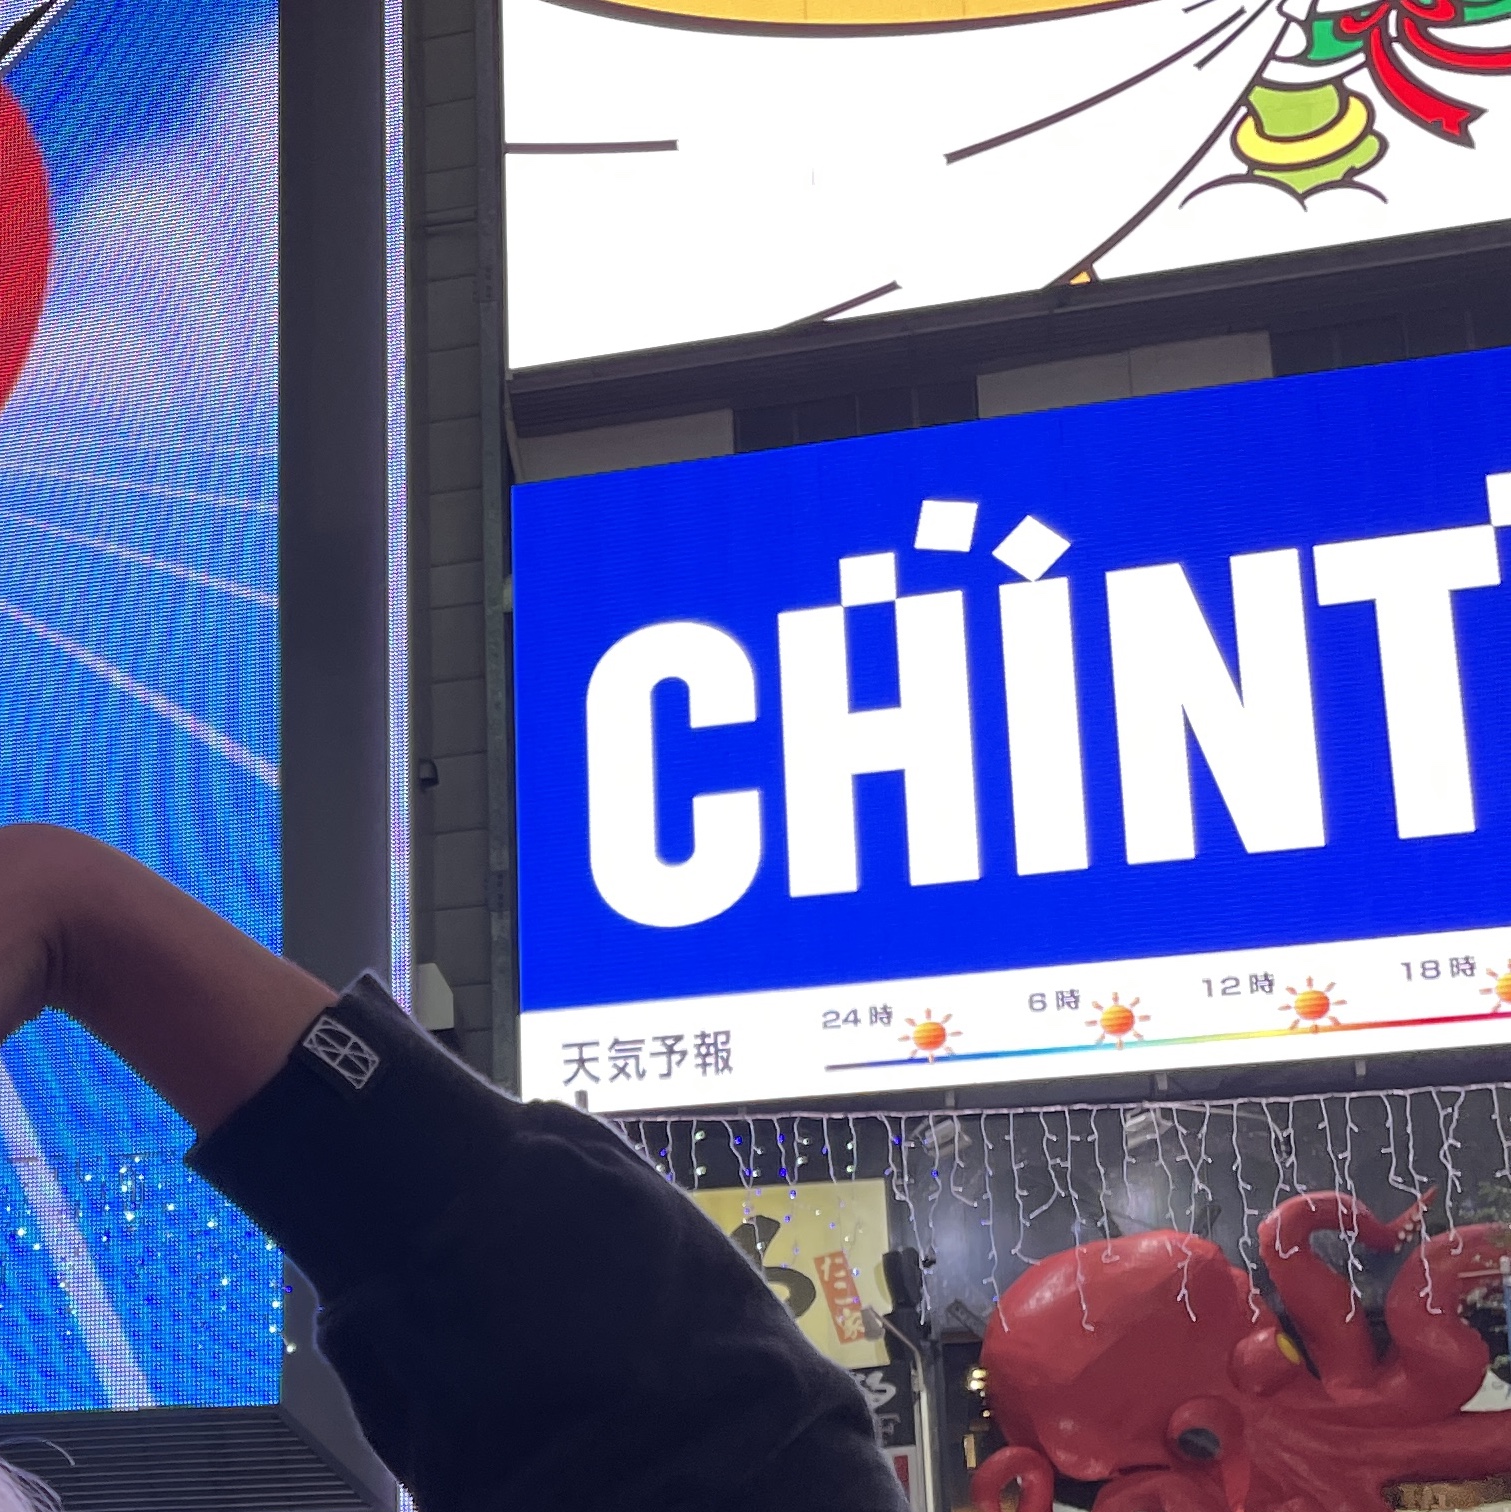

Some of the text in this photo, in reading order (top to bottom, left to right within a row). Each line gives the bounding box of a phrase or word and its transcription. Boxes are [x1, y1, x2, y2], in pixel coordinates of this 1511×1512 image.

[822, 955, 1478, 1030] 24時 6時 12時 18時
[561, 1029, 733, 1087] 天気予報
